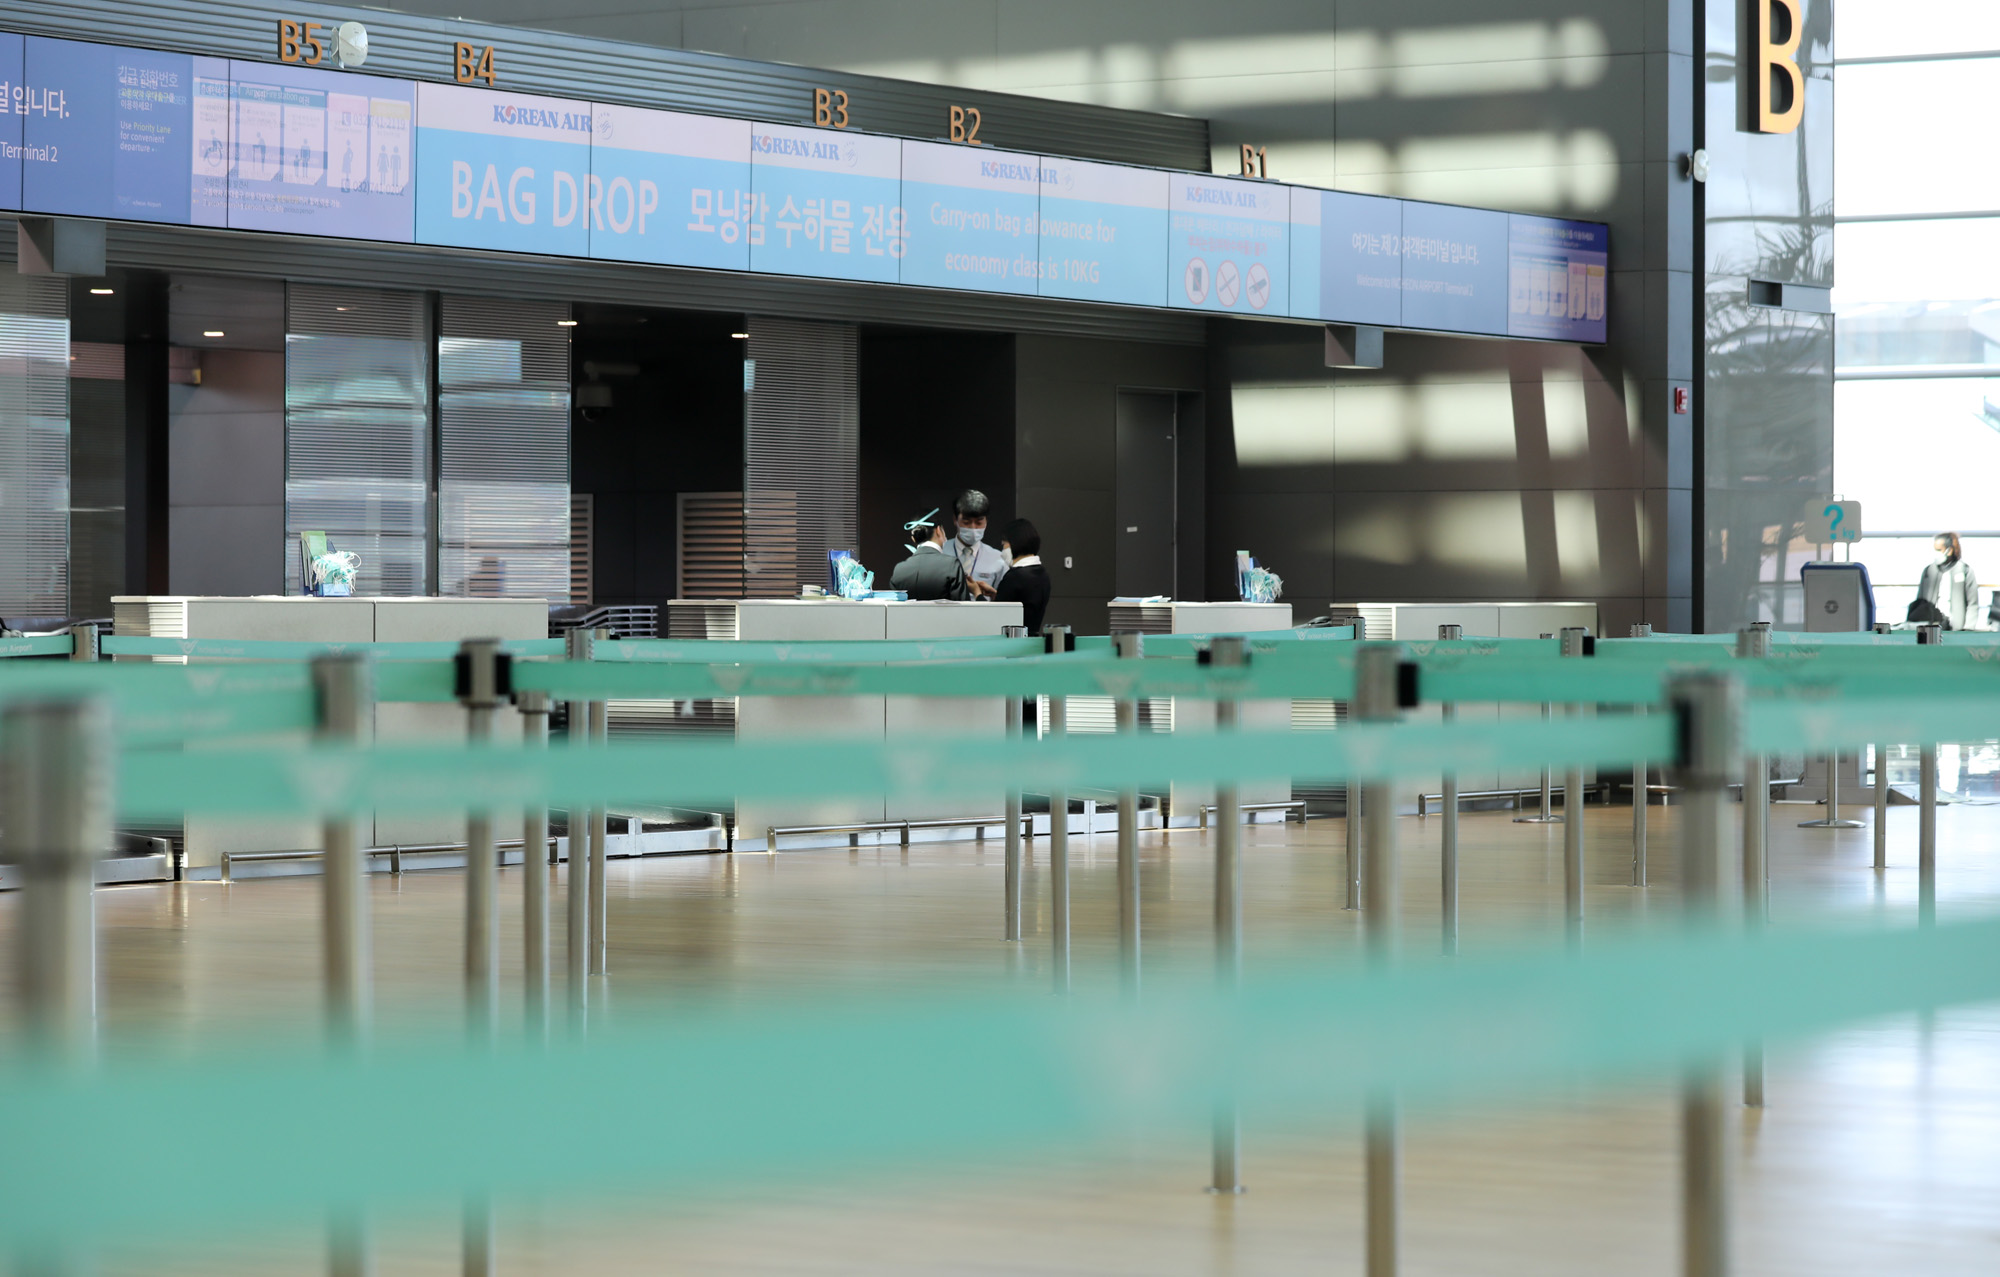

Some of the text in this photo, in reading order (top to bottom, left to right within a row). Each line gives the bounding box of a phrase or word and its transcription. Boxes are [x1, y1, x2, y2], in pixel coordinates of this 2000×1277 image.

[278, 19, 322, 65] B5
[454, 42, 496, 87] B4
[1758, 0, 1804, 134] B
[13, 86, 70, 119] 입니다.
[493, 104, 592, 133] KOREAN AIR
[814, 88, 849, 128] B3
[120, 121, 171, 134] Use Priority Lane
[120, 131, 165, 144] for convenient
[949, 105, 982, 145] B2
[0, 142, 58, 163] Terminal 2
[120, 141, 151, 153] departure
[752, 135, 840, 161] KOREAN AIR
[1240, 143, 1267, 180] B1
[981, 161, 1059, 185] KOREAN AIR
[452, 160, 659, 235] BAG DROP
[1186, 186, 1257, 208] KOREAN AIR
[688, 188, 911, 259] 모닝캄 수하물 전용
[930, 201, 1116, 243] Carry-on bag allowance for
[1352, 232, 1380, 255] 여기는
[1450, 241, 1480, 265] 입니다.
[945, 252, 1099, 284] economy class is 10KG
[1842, 527, 1855, 540] kg
